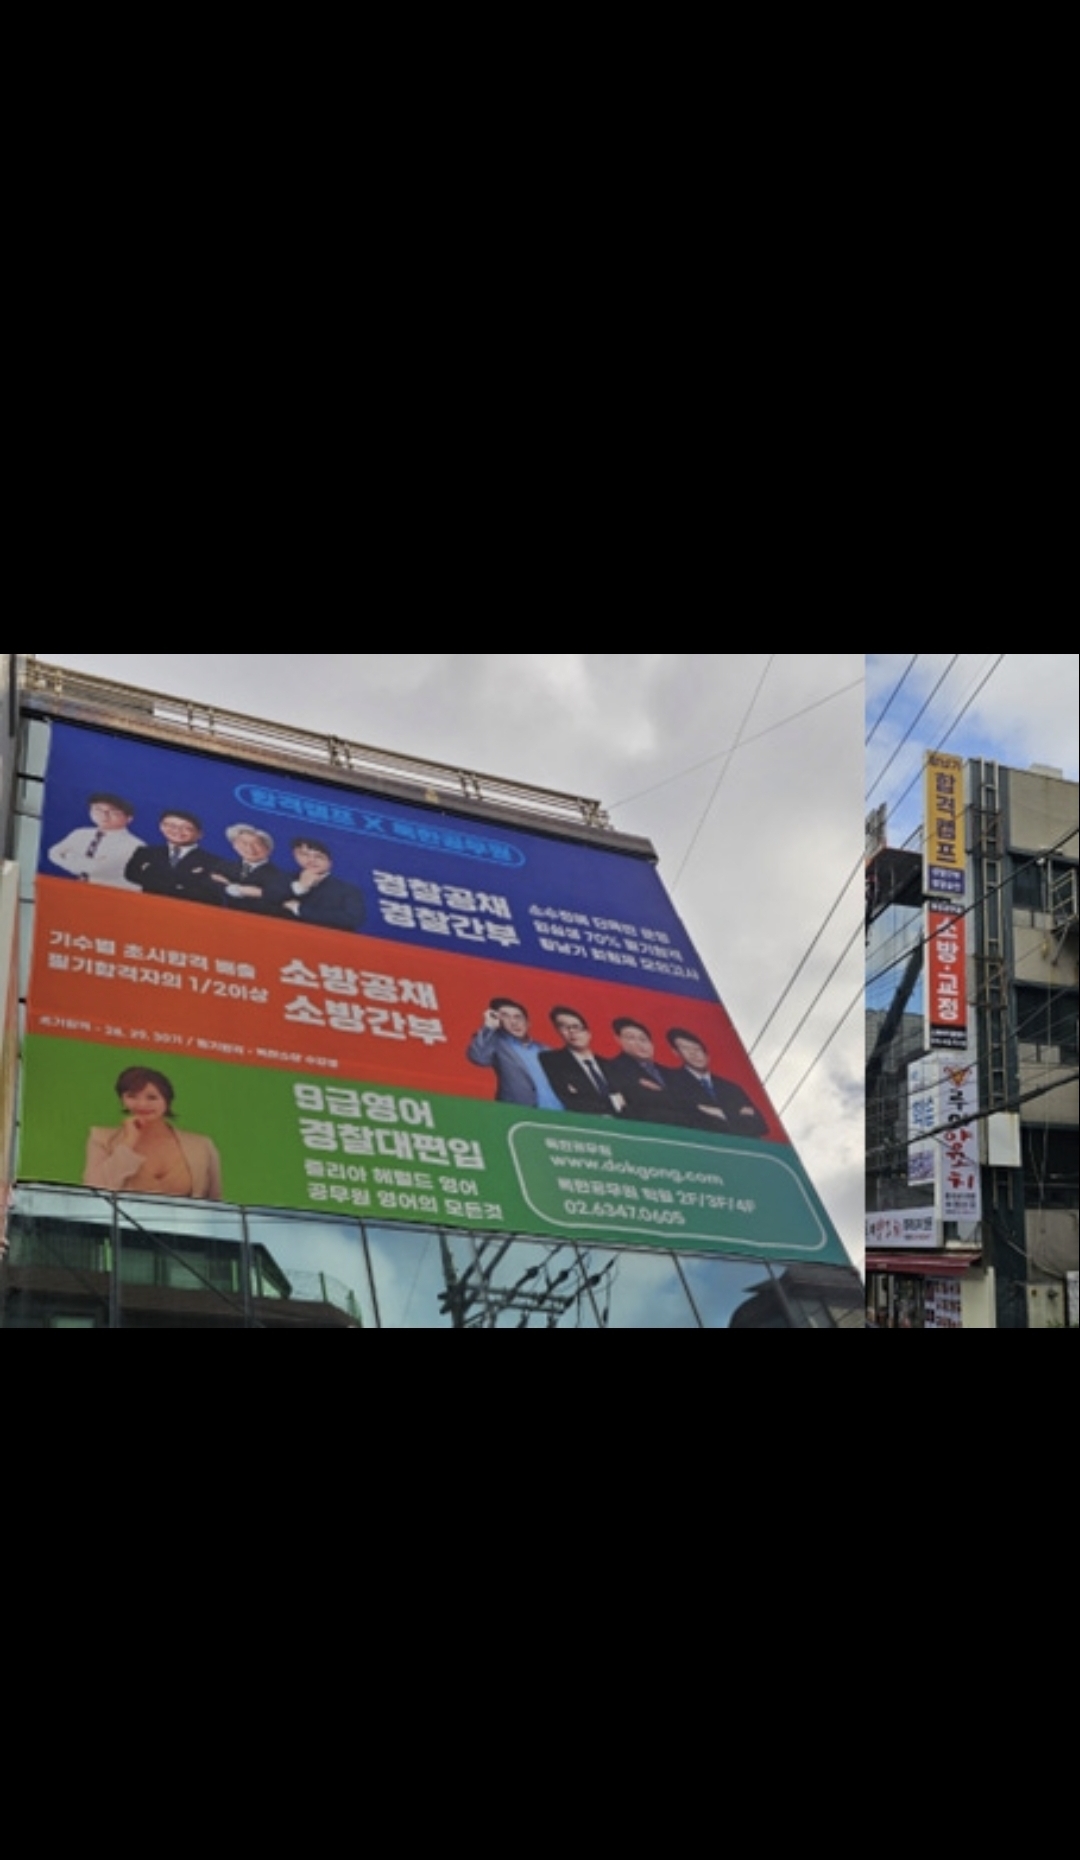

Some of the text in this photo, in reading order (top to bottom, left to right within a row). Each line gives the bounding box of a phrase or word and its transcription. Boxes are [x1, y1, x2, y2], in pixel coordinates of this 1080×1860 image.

[936, 771, 957, 863] 합격캠프
[372, 869, 512, 919] 경찰공채
[379, 899, 521, 946] 경찰간부
[584, 931, 621, 948] 70%
[48, 952, 269, 1003] 필기합격자의 1/2이상
[49, 930, 256, 980] 기수별 초시합격 배출
[639, 957, 700, 981] 모의고사
[279, 957, 439, 1011] 소방공채
[284, 996, 447, 1046] 소방간부
[294, 1082, 435, 1128] 9급영어
[299, 1118, 486, 1171] 경찰대편입
[439, 1175, 479, 1196] 영어
[550, 1155, 724, 1186] www.dokgong.com
[307, 1181, 504, 1221] 공무원 영어의 모든것
